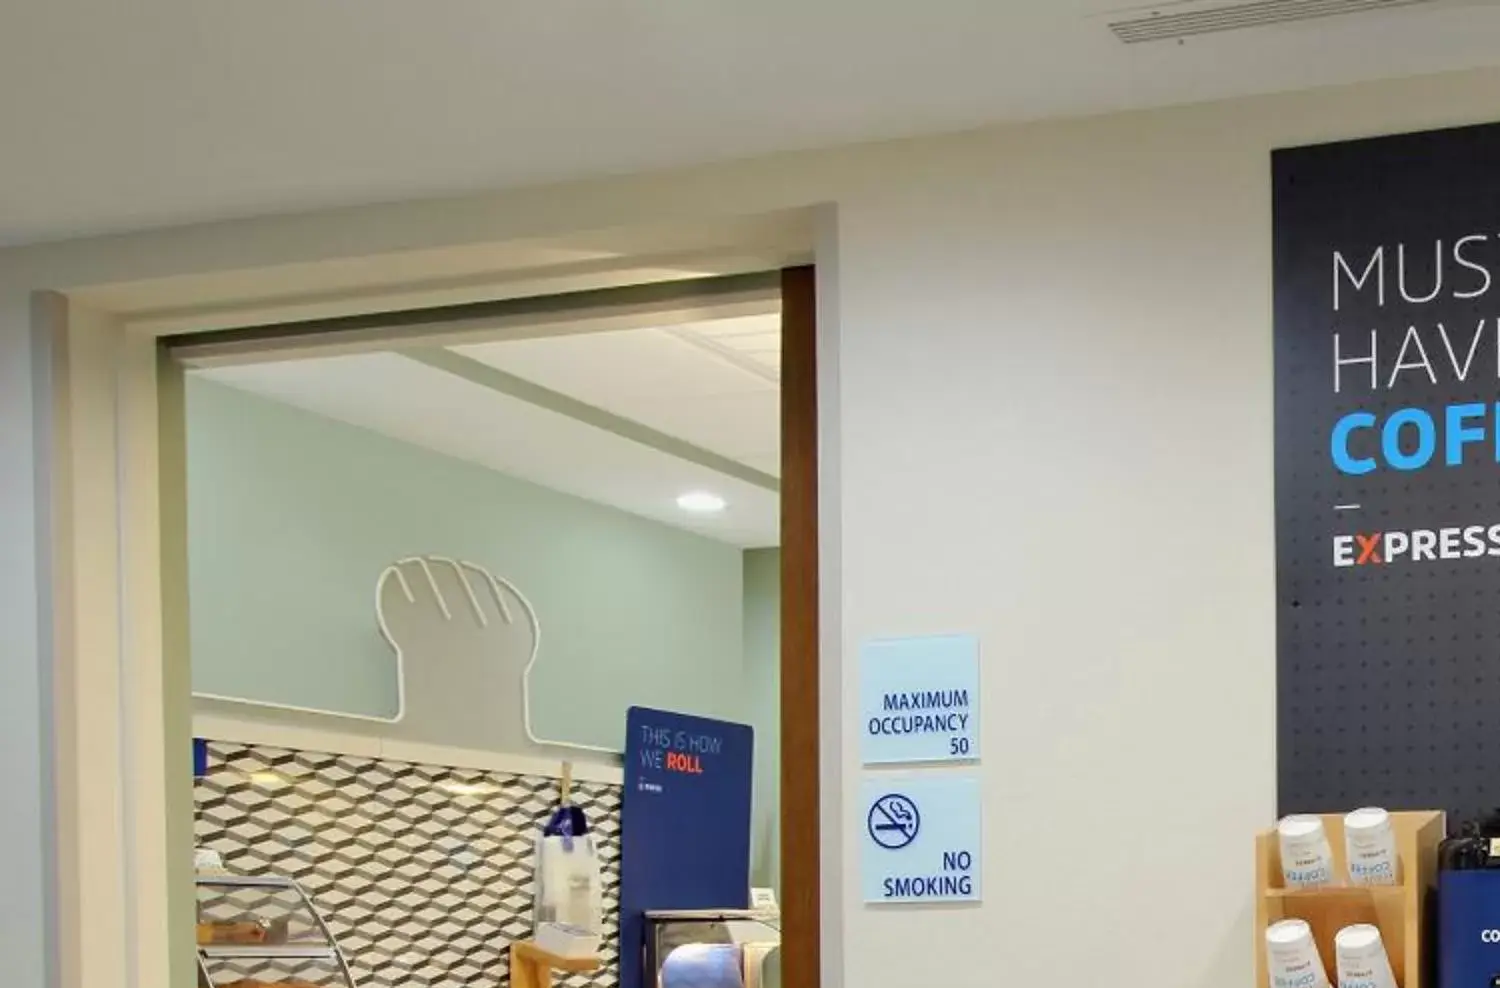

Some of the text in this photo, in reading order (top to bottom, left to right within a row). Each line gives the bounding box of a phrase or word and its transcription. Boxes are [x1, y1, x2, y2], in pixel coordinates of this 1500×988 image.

[883, 689, 969, 711] MAXIMUM
[868, 713, 969, 735] OCCUPANCY
[641, 725, 723, 754] THIS IS HOW
[949, 737, 970, 755] 50
[640, 748, 704, 774] WE ROLL
[942, 851, 972, 871] NO
[883, 876, 972, 897] SMOKING
